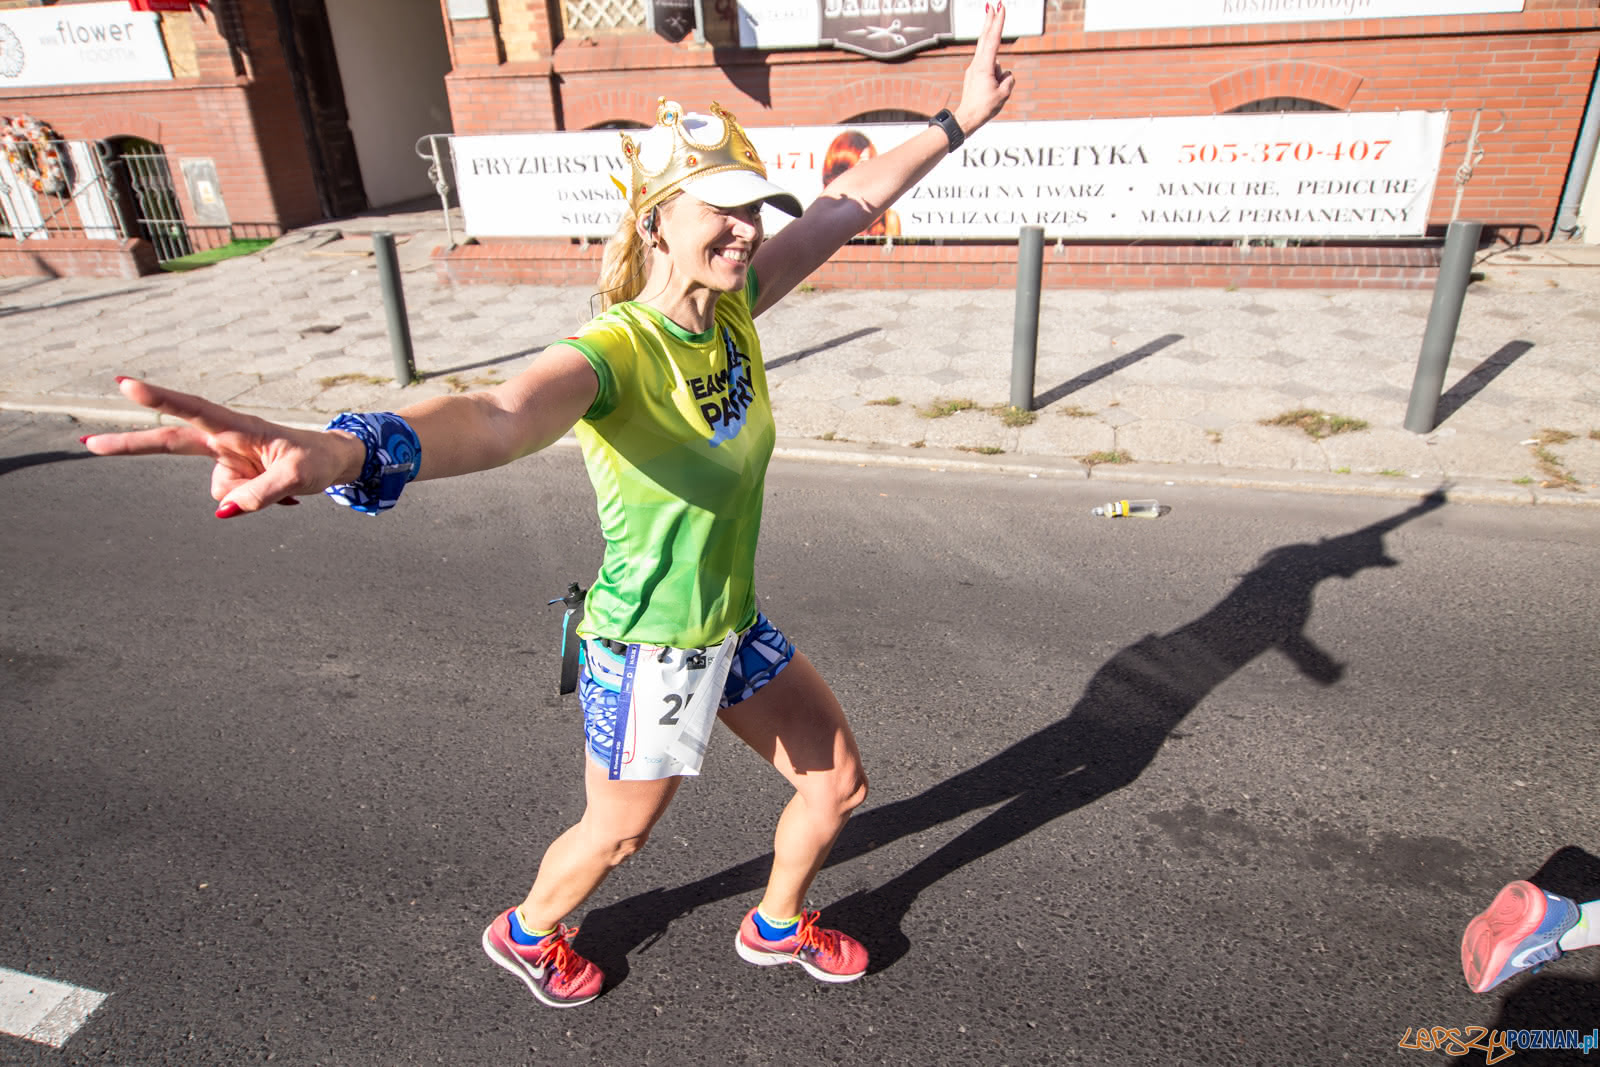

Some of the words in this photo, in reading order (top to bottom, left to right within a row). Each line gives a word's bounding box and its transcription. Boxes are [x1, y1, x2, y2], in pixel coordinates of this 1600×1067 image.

[57, 20, 134, 45] flower
[962, 144, 1149, 168] KOSMETYKA
[1178, 140, 1392, 163] 505-370-407
[912, 184, 990, 199] ZABIEGI
[996, 184, 1024, 198] NA
[1033, 183, 1105, 198] TWARZ
[1157, 182, 1281, 197] MANICURE,
[1297, 178, 1417, 195] PEDICURE
[911, 211, 1028, 224] STYLIZACJA
[1238, 207, 1416, 223] PERMANENTNY
[686, 368, 729, 401] EAM
